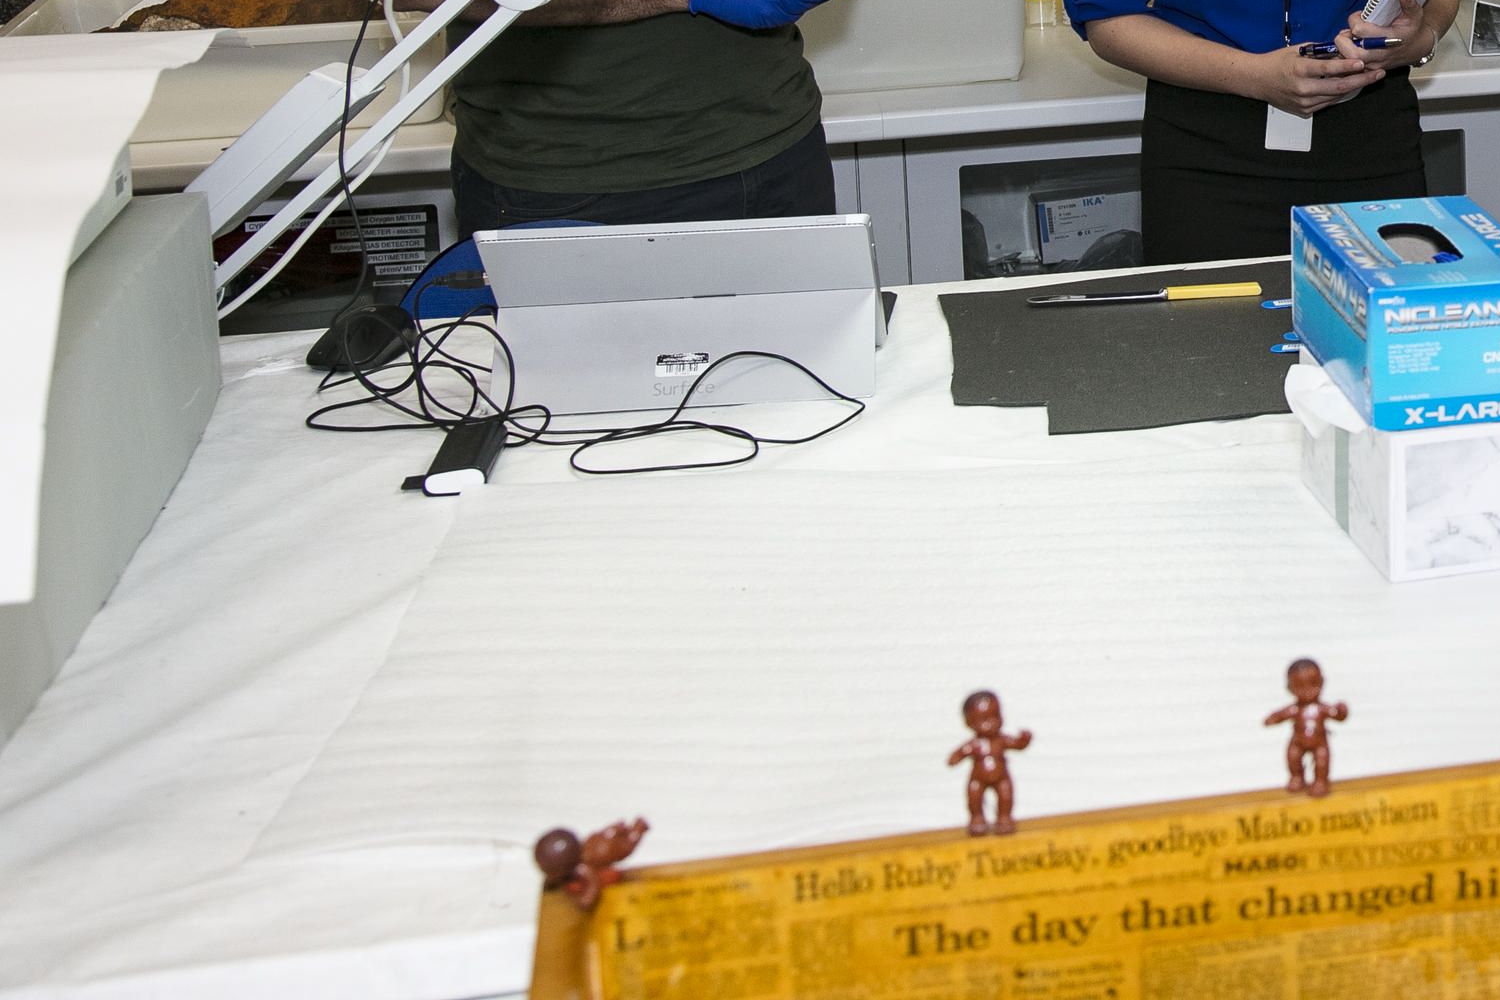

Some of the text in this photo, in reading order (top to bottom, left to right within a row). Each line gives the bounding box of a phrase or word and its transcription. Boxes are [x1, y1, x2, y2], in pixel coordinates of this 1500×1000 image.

[396, 213, 422, 221] METER
[381, 239, 421, 248] DETECTOR
[653, 382, 715, 396] Surfce
[793, 797, 1440, 902] Hello Ruby Tuesday, goodbye Mabo mayhem
[894, 921, 992, 958] The
[1010, 908, 1099, 948] day
[1120, 896, 1220, 935] that
[1237, 872, 1436, 922] changed
